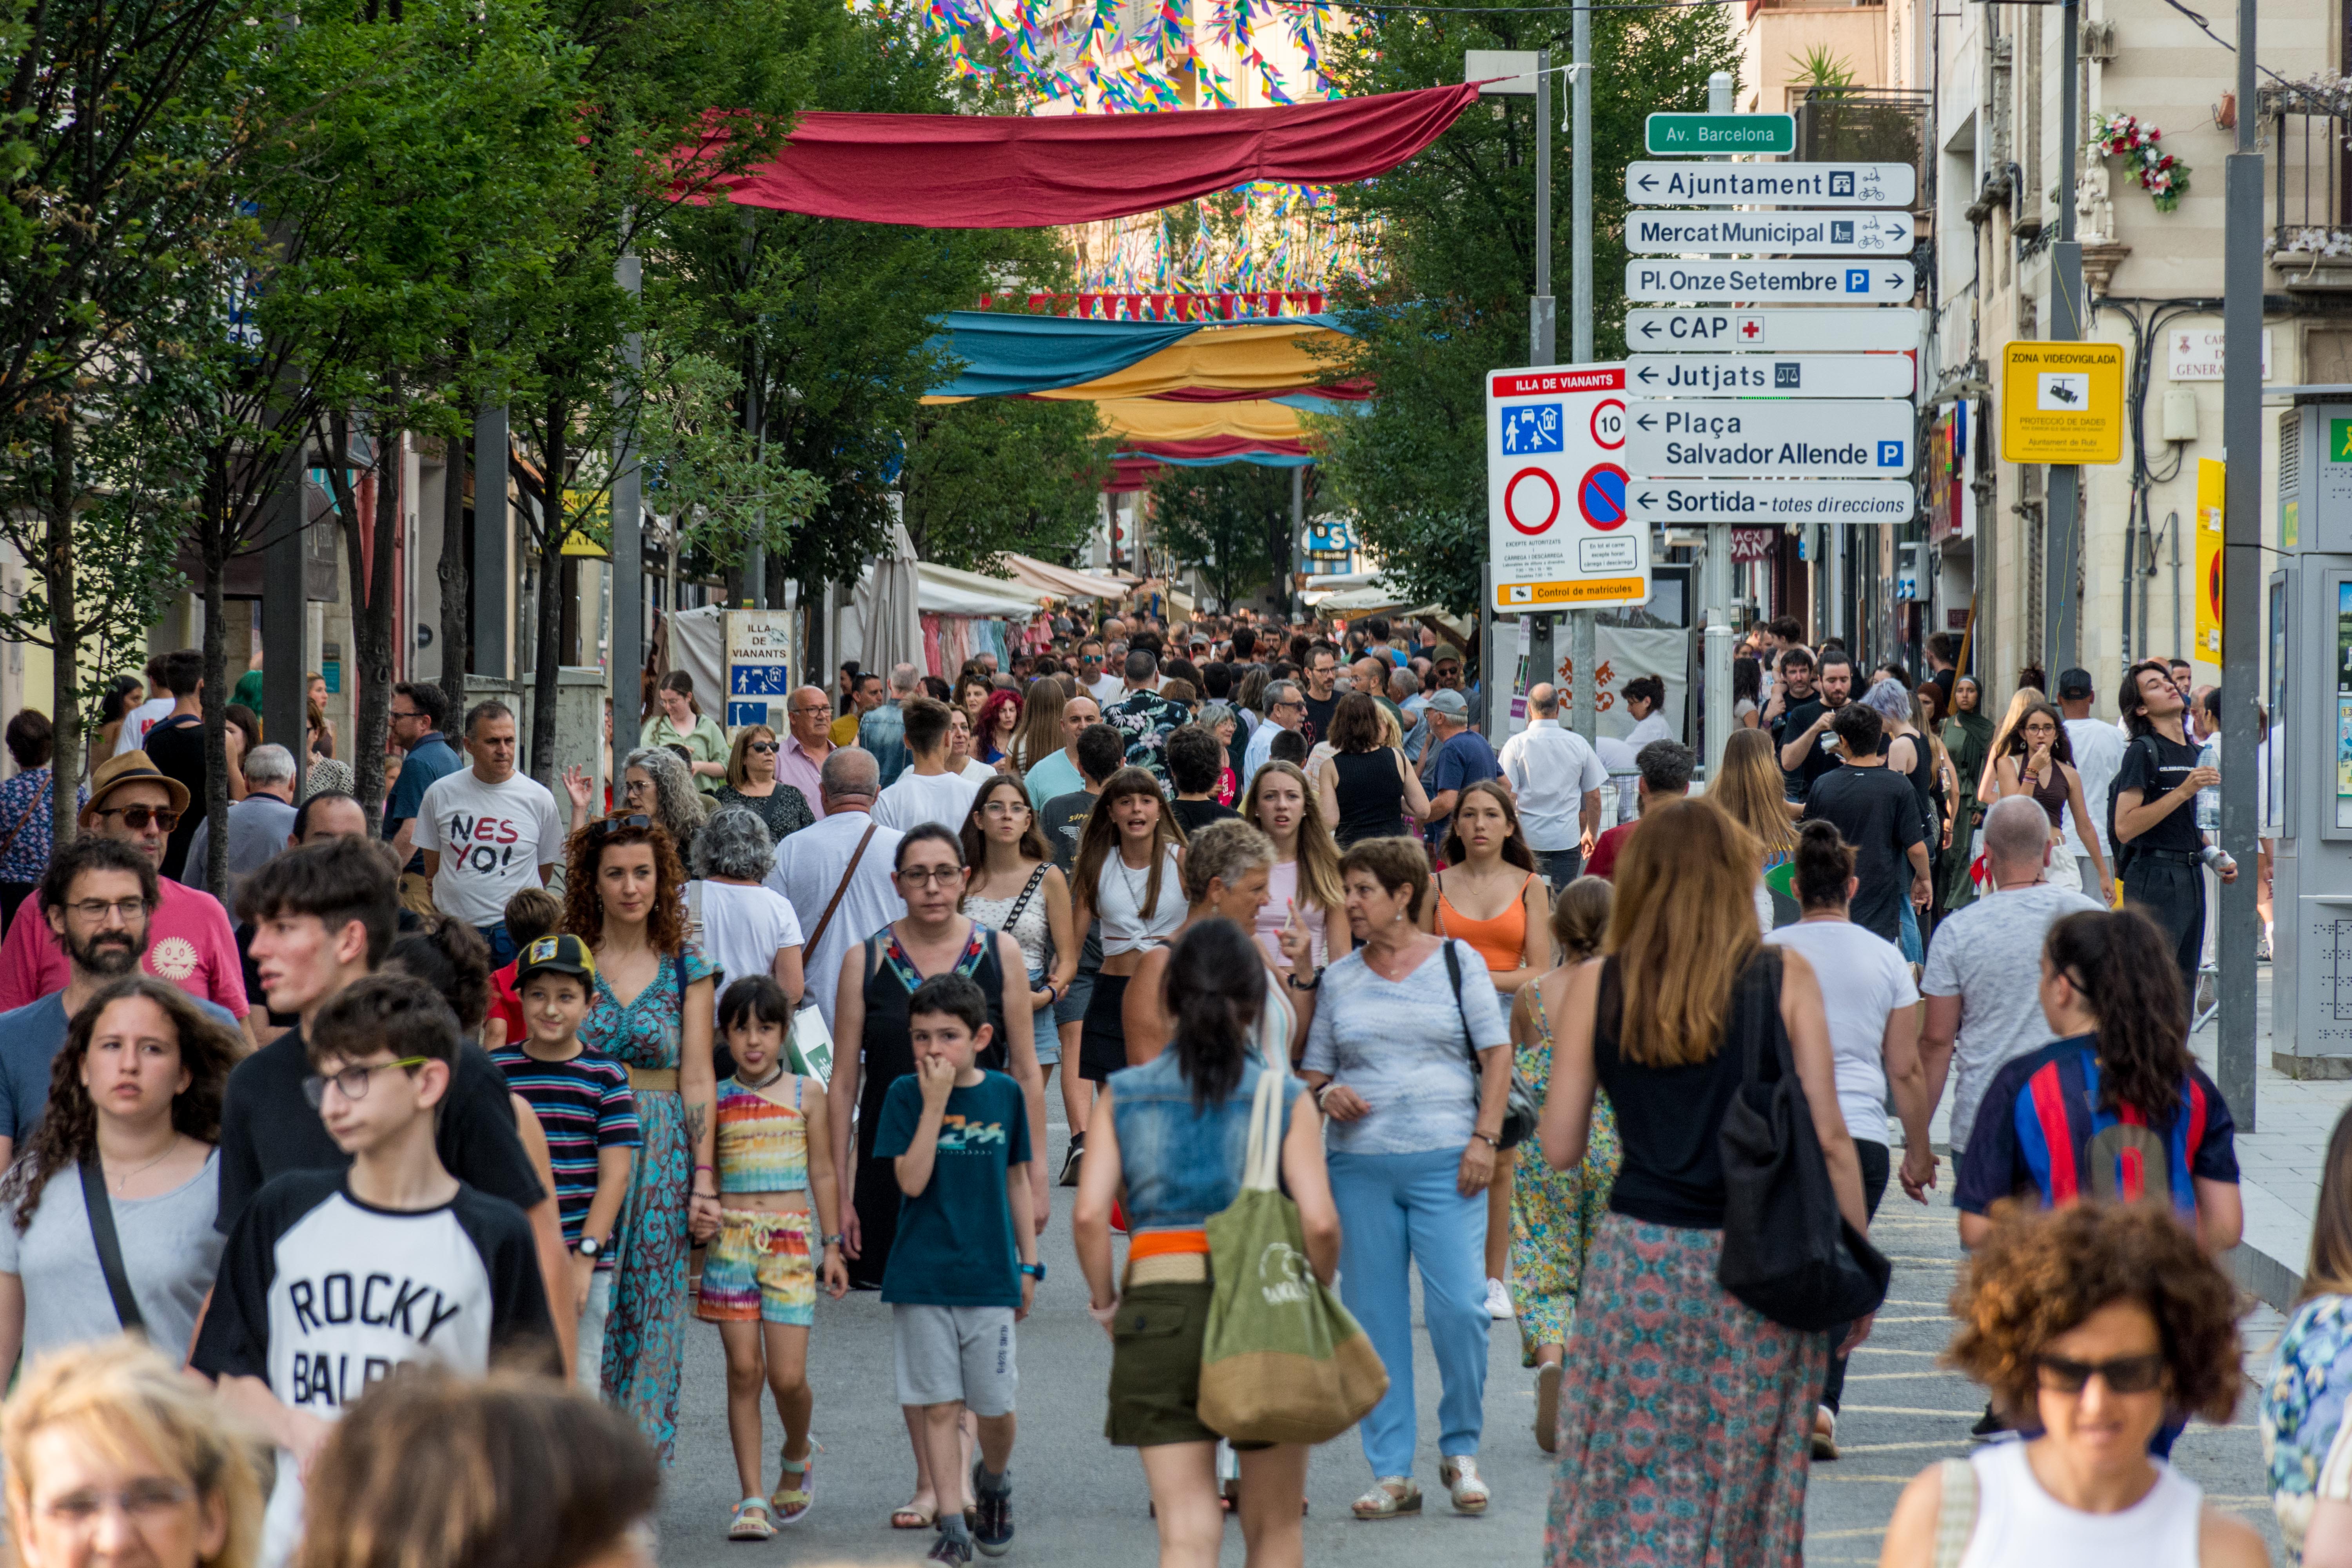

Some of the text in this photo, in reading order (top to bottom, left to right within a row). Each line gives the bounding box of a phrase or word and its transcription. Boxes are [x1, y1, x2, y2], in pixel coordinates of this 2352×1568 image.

[1666, 127, 1774, 141] Av. Barcelona
[1668, 173, 1821, 198] Ajuntament
[1642, 223, 1823, 246] Mercat Municipal
[1642, 271, 1665, 289] Pl.
[1670, 271, 1725, 290] Onze
[1730, 271, 1837, 290] Setembre
[1670, 317, 1727, 338] CAP
[2205, 335, 2225, 345] CAR
[2012, 354, 2116, 364] ZONA VIDEOVIGILADA
[2215, 350, 2225, 359] D
[1668, 365, 1764, 390] Jutjats
[2177, 364, 2225, 375] GENERA
[1516, 374, 1613, 391] ILLA DE VIANANTS
[1602, 416, 1621, 432] 10
[1667, 412, 1740, 439] Plaça
[2020, 417, 2064, 425] PROTECCIÓ
[1667, 443, 1773, 464] Salvador
[1779, 443, 1867, 464] Allende
[1667, 490, 1754, 511] Sortida
[1773, 497, 1812, 512] totes
[1818, 497, 1904, 512] direccions
[1538, 584, 1632, 598] Control de matrícules
[733, 649, 786, 658] VIANANTS
[1068, 813, 1089, 822] SUPP
[451, 814, 518, 844] NES
[450, 842, 512, 876] YO!
[290, 1272, 460, 1345] ROCKY
